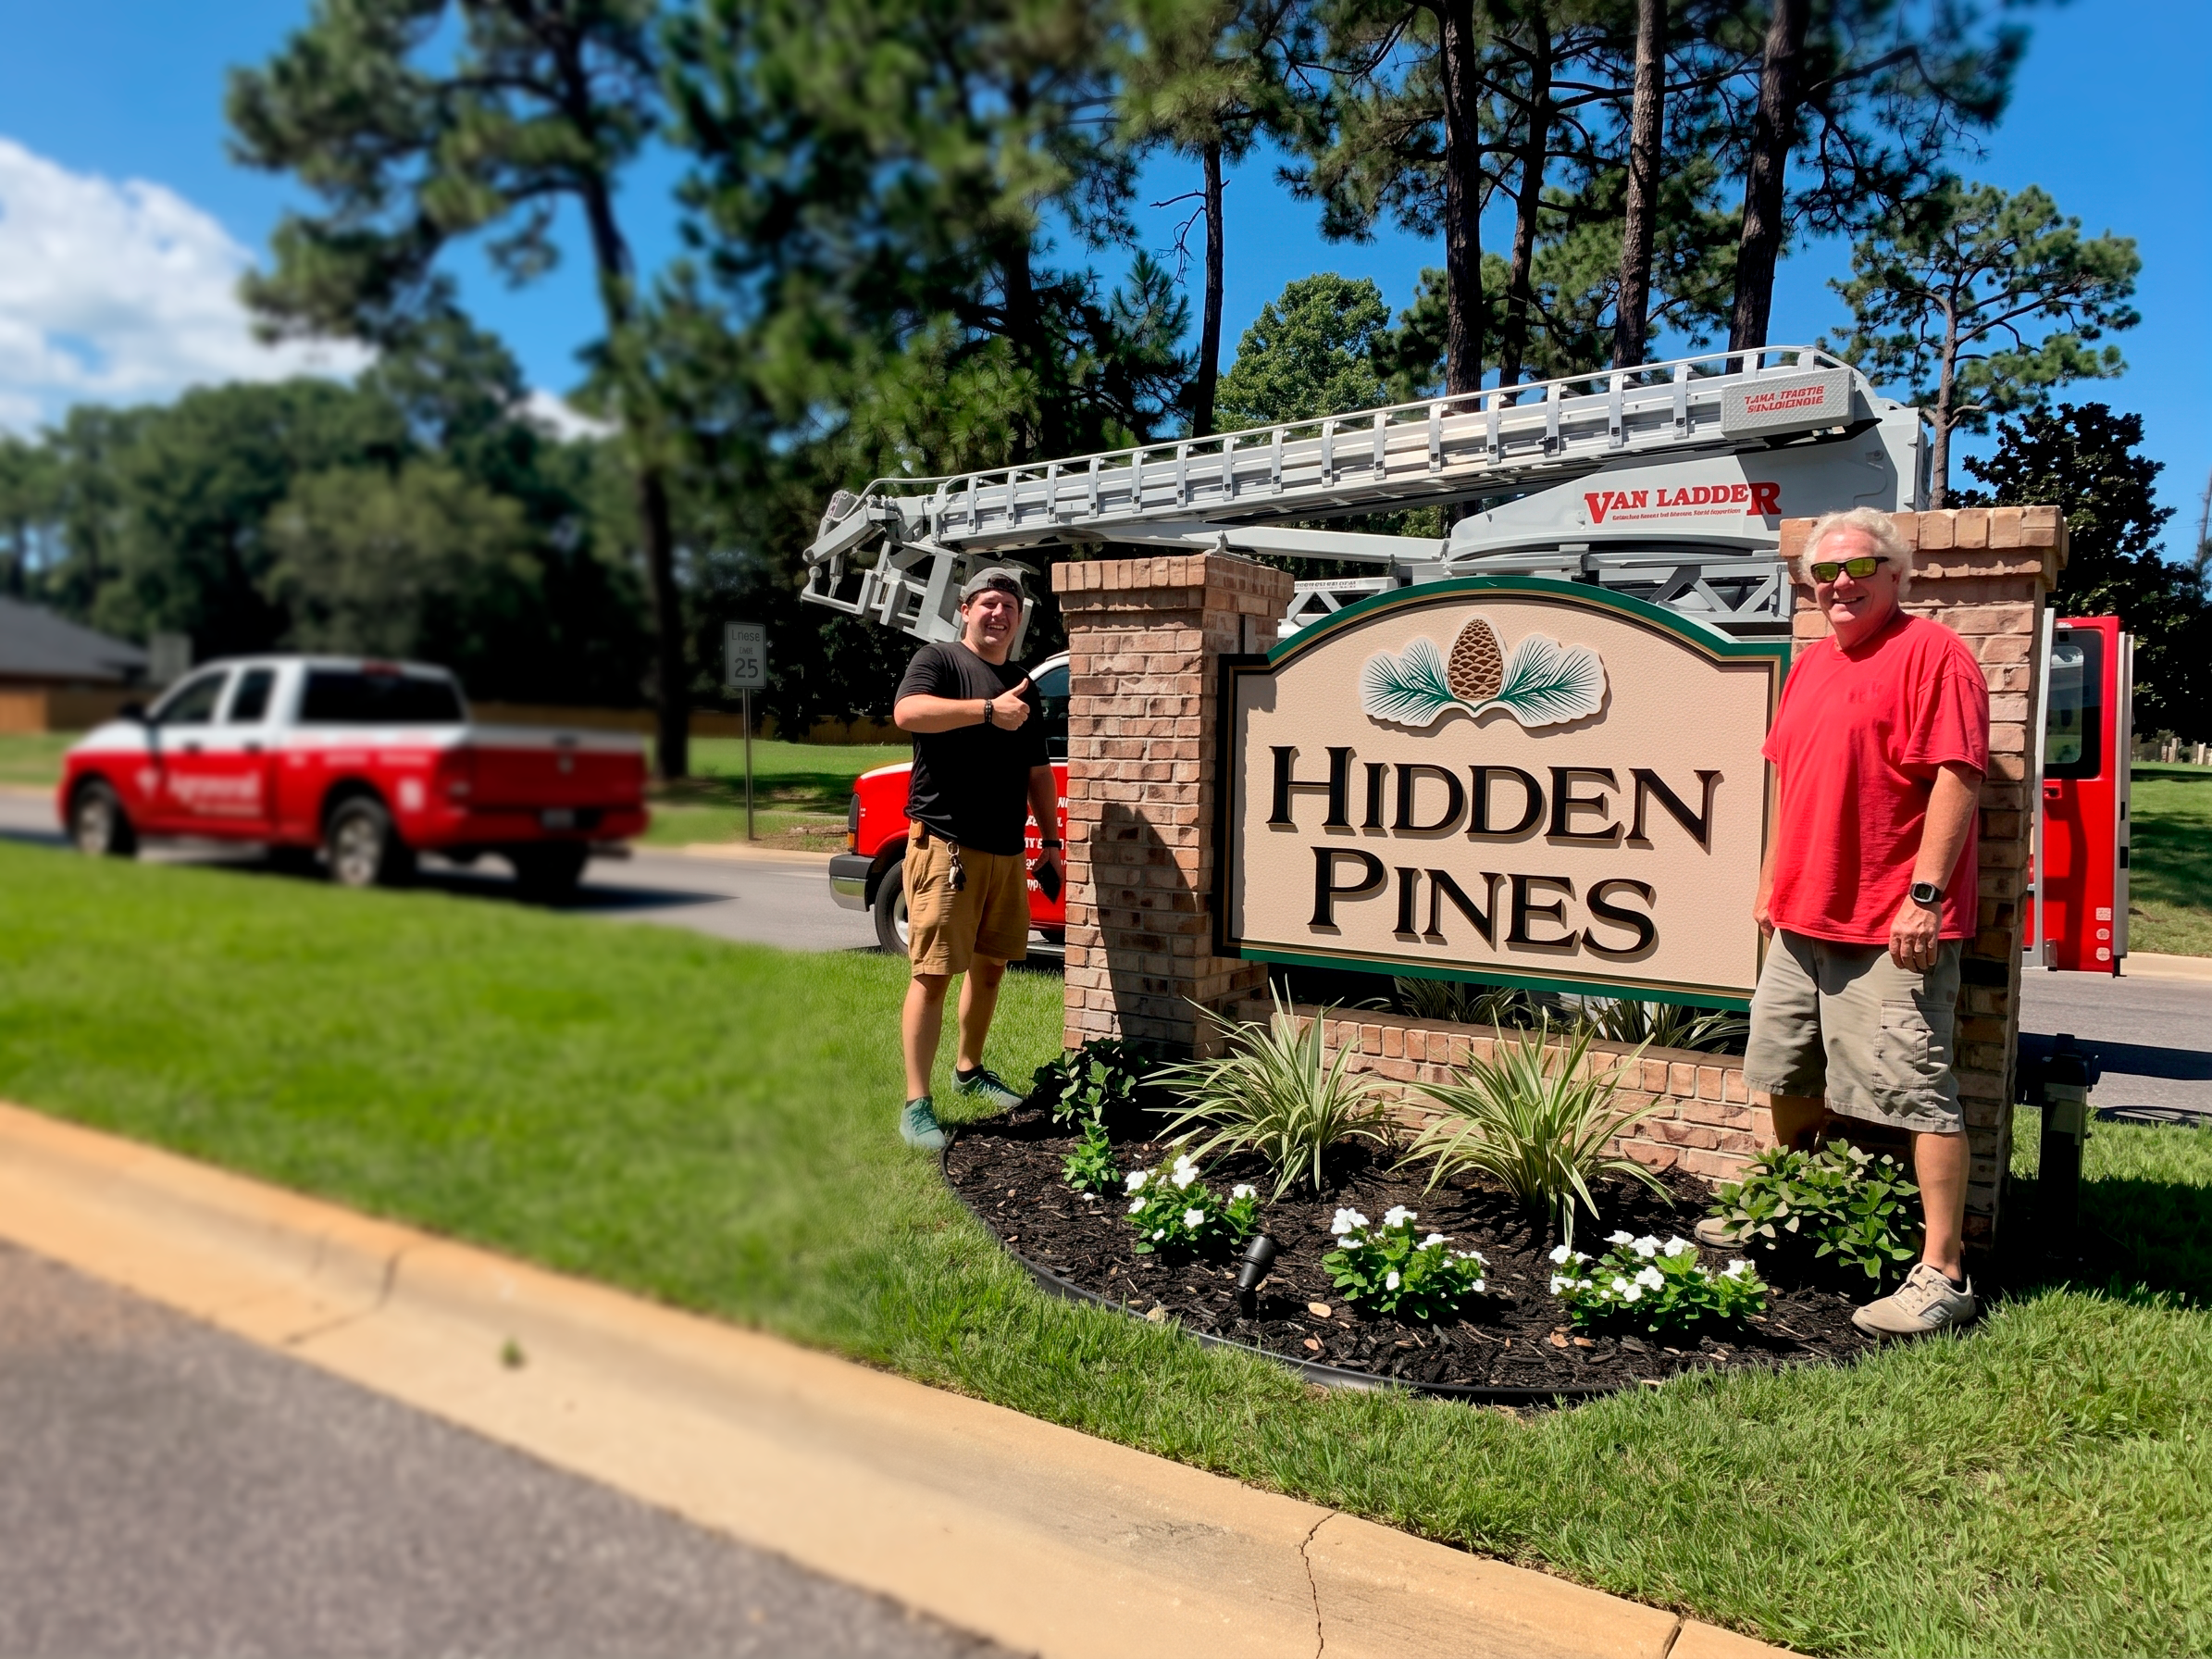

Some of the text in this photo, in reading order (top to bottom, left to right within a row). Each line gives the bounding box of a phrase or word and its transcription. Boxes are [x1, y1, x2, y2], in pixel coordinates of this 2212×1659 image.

[1584, 481, 1783, 524] VAN LADDER
[734, 657, 759, 679] 25
[1265, 745, 1723, 847] HIDDEN
[1307, 845, 1657, 954] PINES
